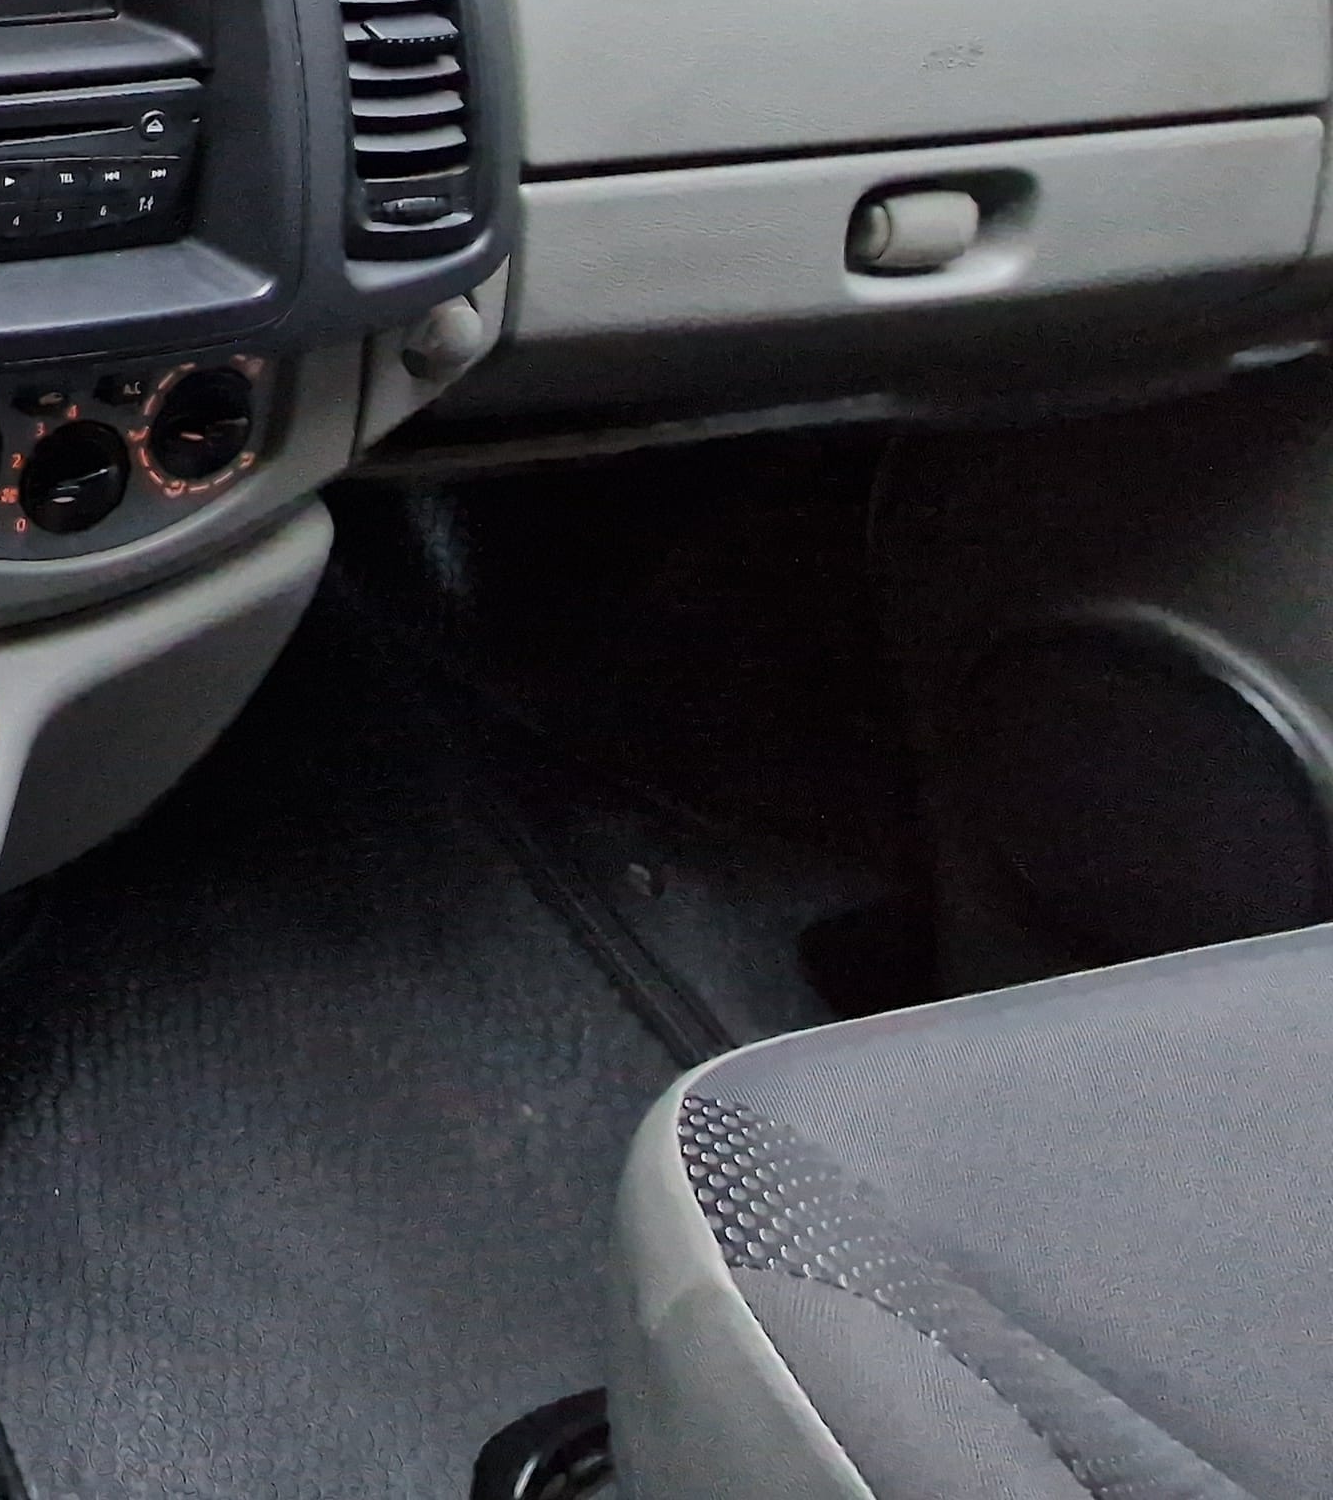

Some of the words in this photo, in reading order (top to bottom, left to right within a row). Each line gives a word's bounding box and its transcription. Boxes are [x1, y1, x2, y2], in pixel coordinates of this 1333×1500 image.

[59, 173, 74, 183] TEL
[68, 404, 79, 419] 4
[36, 422, 45, 437] 3
[11, 453, 22, 468] 2
